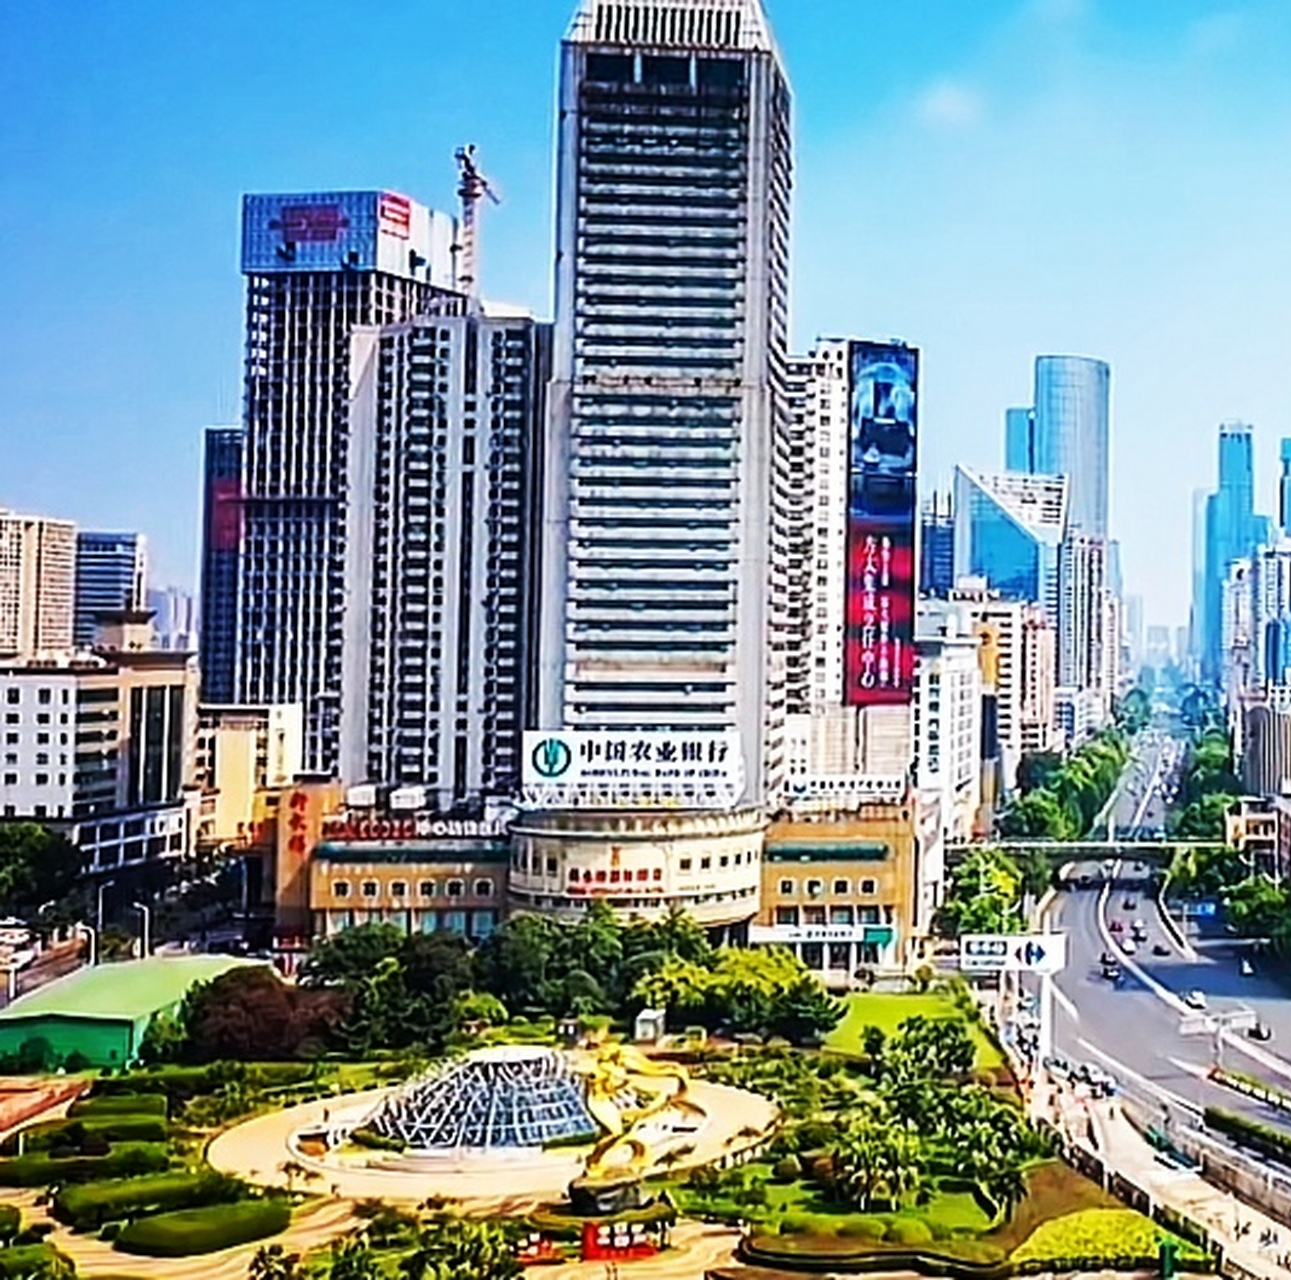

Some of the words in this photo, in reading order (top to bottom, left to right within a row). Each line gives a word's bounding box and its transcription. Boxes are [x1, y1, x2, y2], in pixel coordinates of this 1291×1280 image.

[580, 739, 729, 763] 中国农业银行
